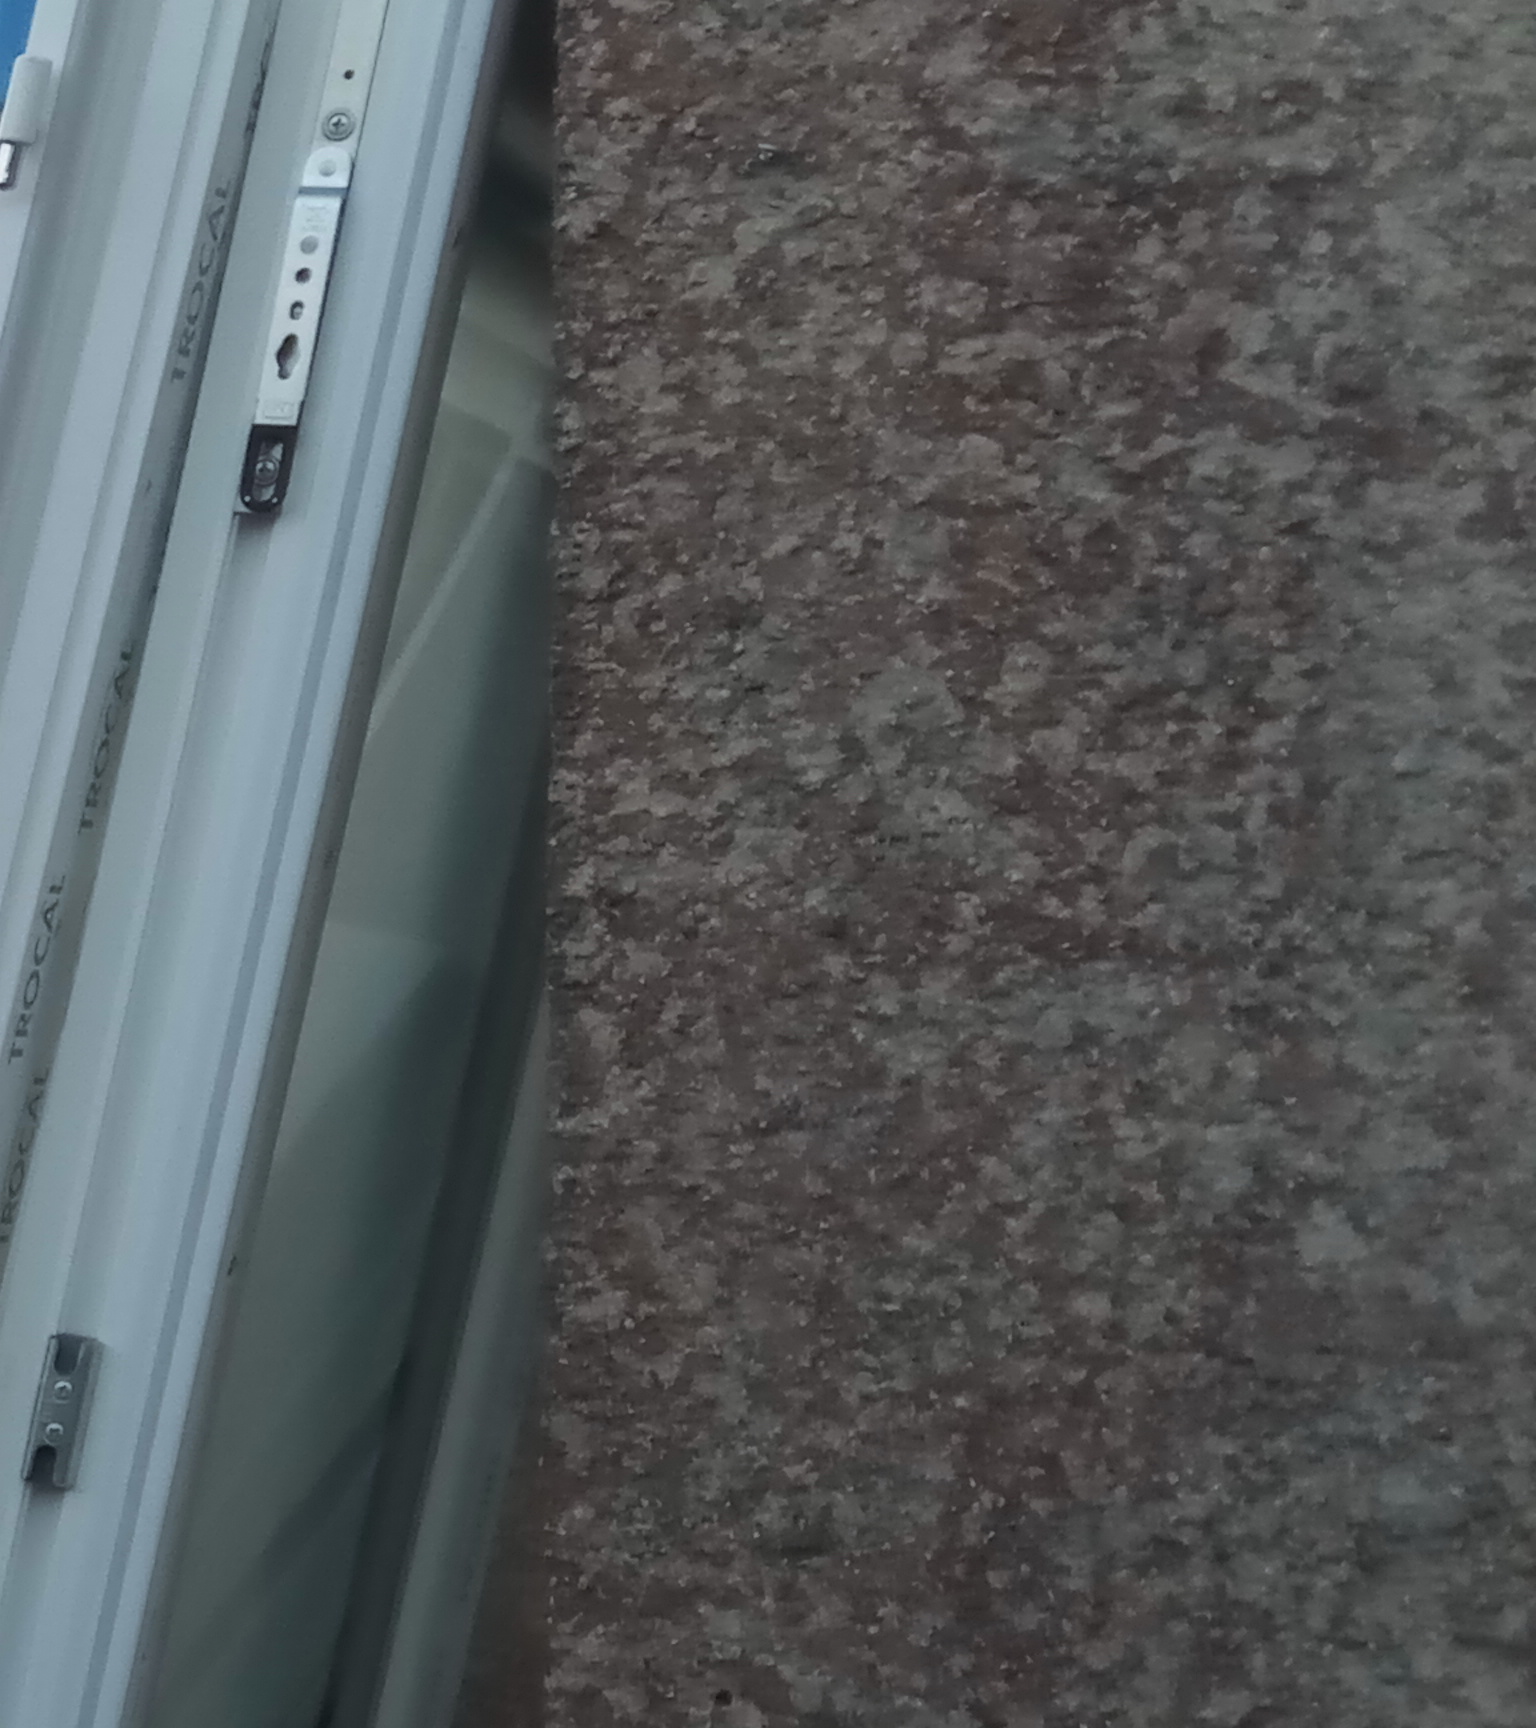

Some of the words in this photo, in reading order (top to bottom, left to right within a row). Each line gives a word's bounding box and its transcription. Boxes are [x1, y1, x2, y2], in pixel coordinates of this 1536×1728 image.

[170, 181, 234, 386] TROCAL
[77, 647, 133, 837] TROCAL
[6, 872, 66, 1067] TROCAL
